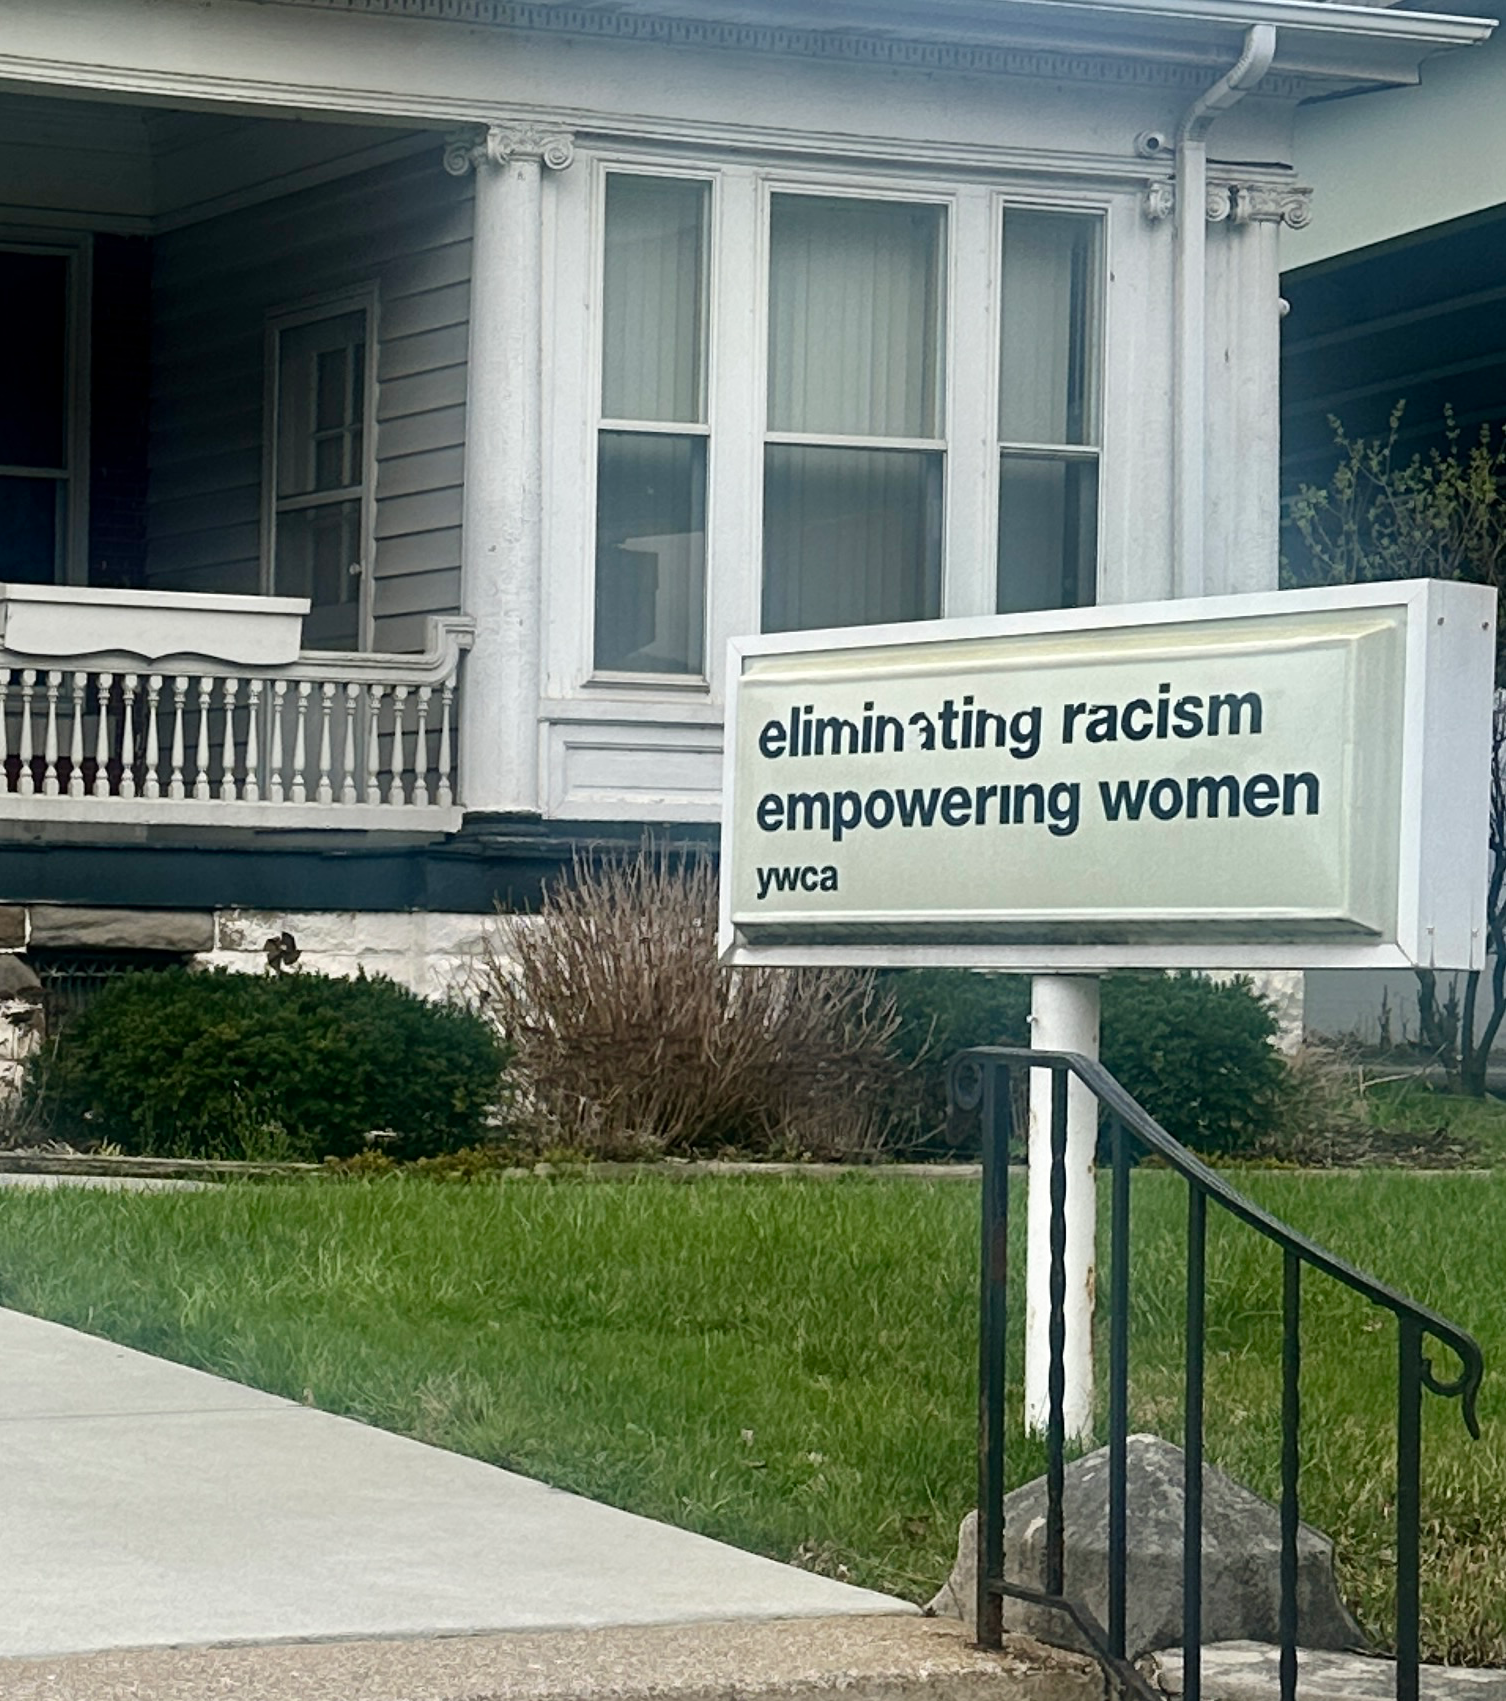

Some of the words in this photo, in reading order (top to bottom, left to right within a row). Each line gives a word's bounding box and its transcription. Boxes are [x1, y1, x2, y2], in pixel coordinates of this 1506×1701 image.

[758, 695, 1042, 760] eliminating
[1062, 682, 1263, 745] racism
[756, 782, 1081, 842] empowering
[1098, 771, 1320, 822] women
[756, 865, 839, 900] ywca
